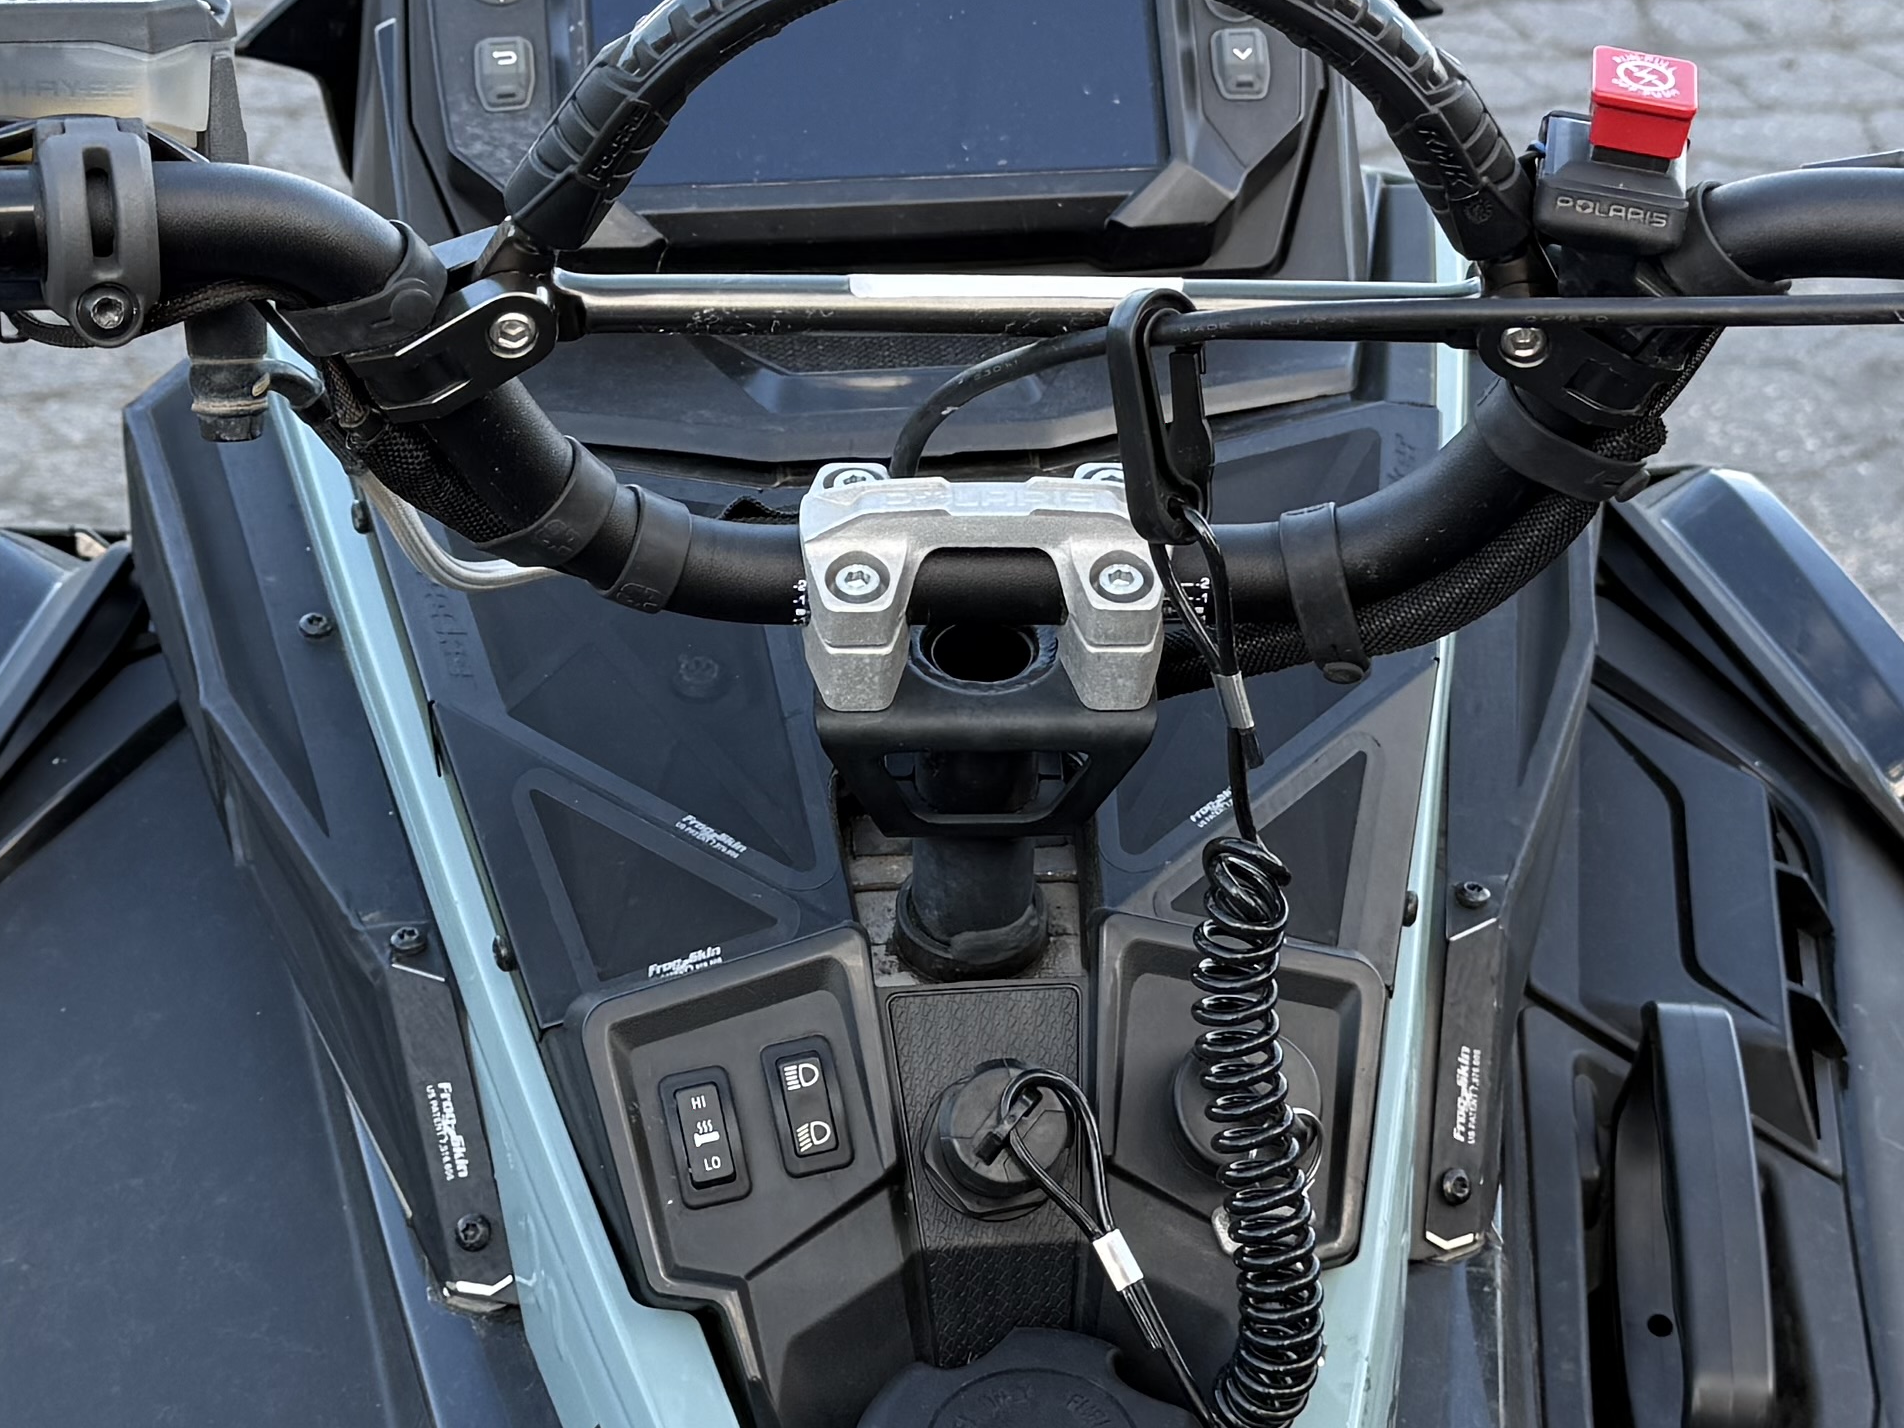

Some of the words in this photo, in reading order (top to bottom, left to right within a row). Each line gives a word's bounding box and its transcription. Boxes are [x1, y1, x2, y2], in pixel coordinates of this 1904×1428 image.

[1556, 196, 1668, 229] POLARIS
[691, 1095, 707, 1110] HI
[704, 1156, 722, 1171] LO
